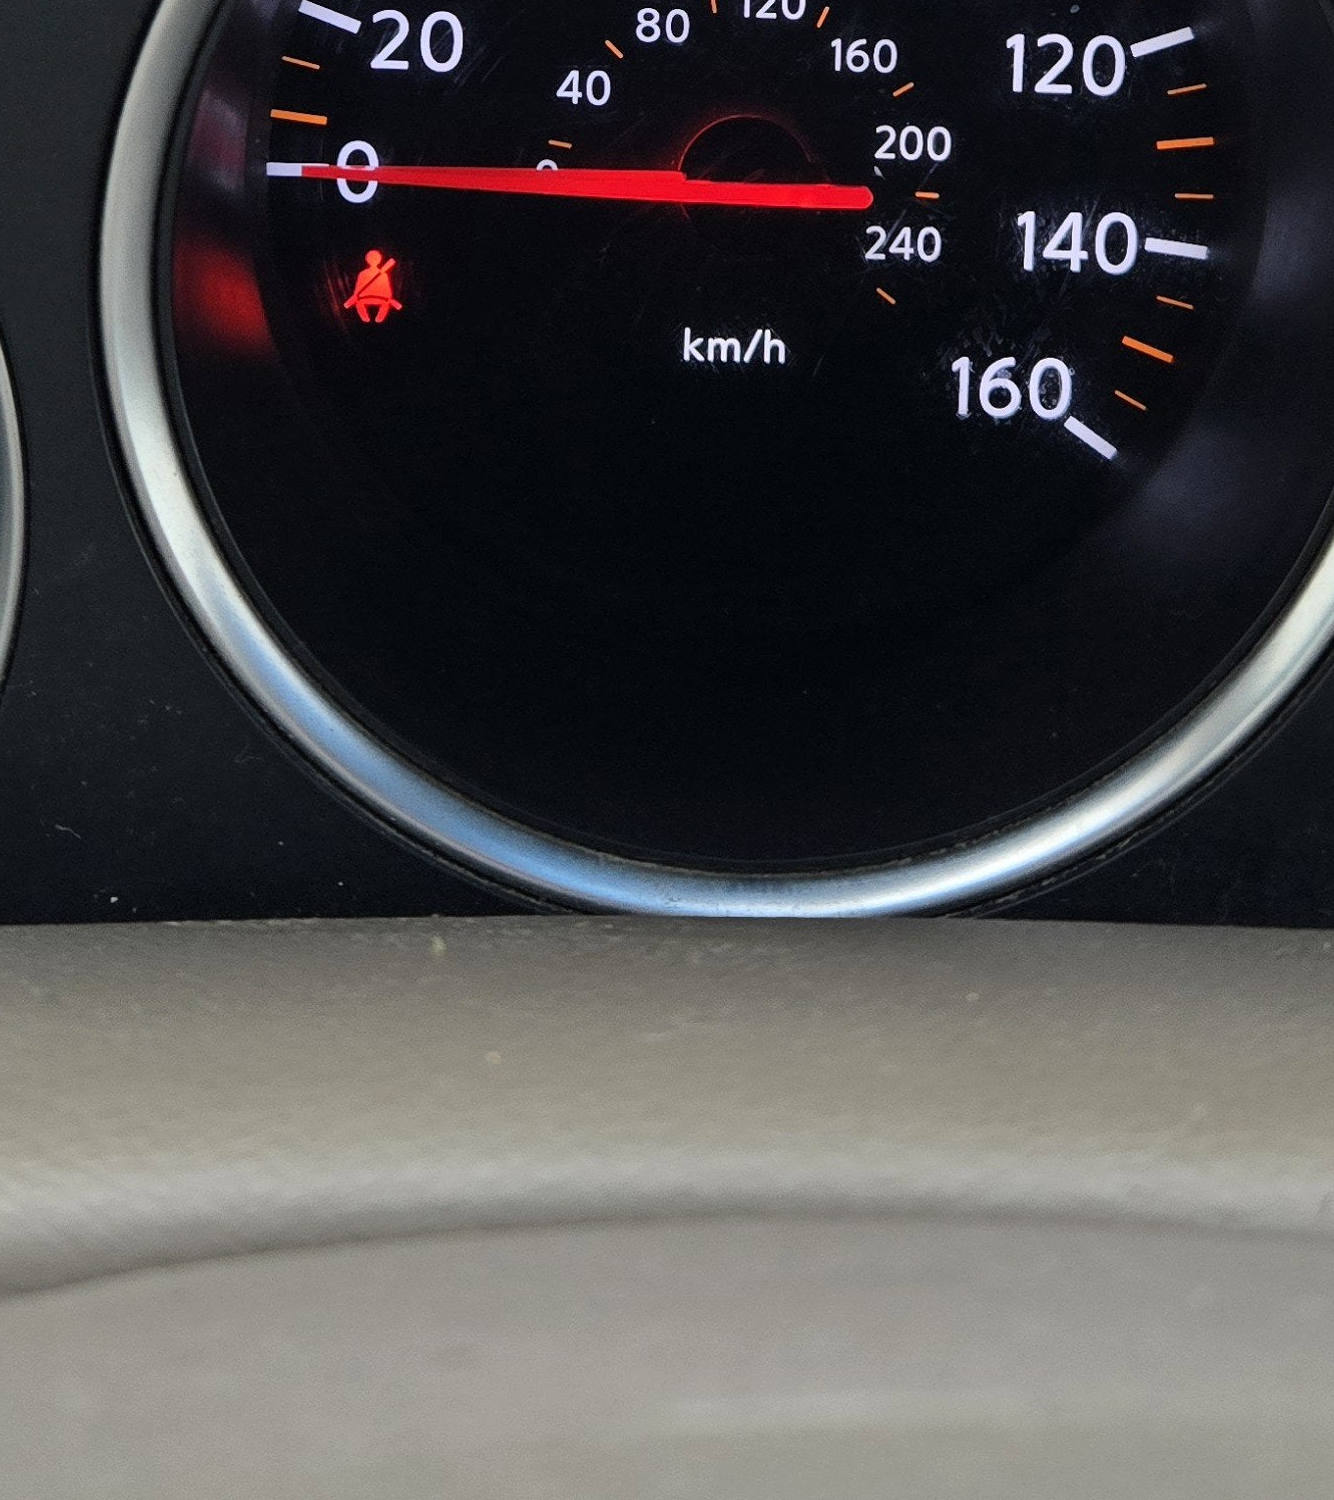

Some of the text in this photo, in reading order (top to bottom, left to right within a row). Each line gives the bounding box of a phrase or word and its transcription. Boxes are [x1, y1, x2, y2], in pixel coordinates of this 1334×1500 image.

[371, 10, 463, 72] 20
[636, 8, 689, 43] 80
[832, 38, 897, 73] 160
[1007, 34, 1126, 96] 120
[557, 70, 610, 105] 40
[875, 125, 951, 161] 200
[337, 140, 379, 203] 0
[865, 226, 941, 262] 240
[1018, 211, 1137, 274] 140
[684, 328, 785, 363] km/h
[951, 355, 1071, 418] 160
